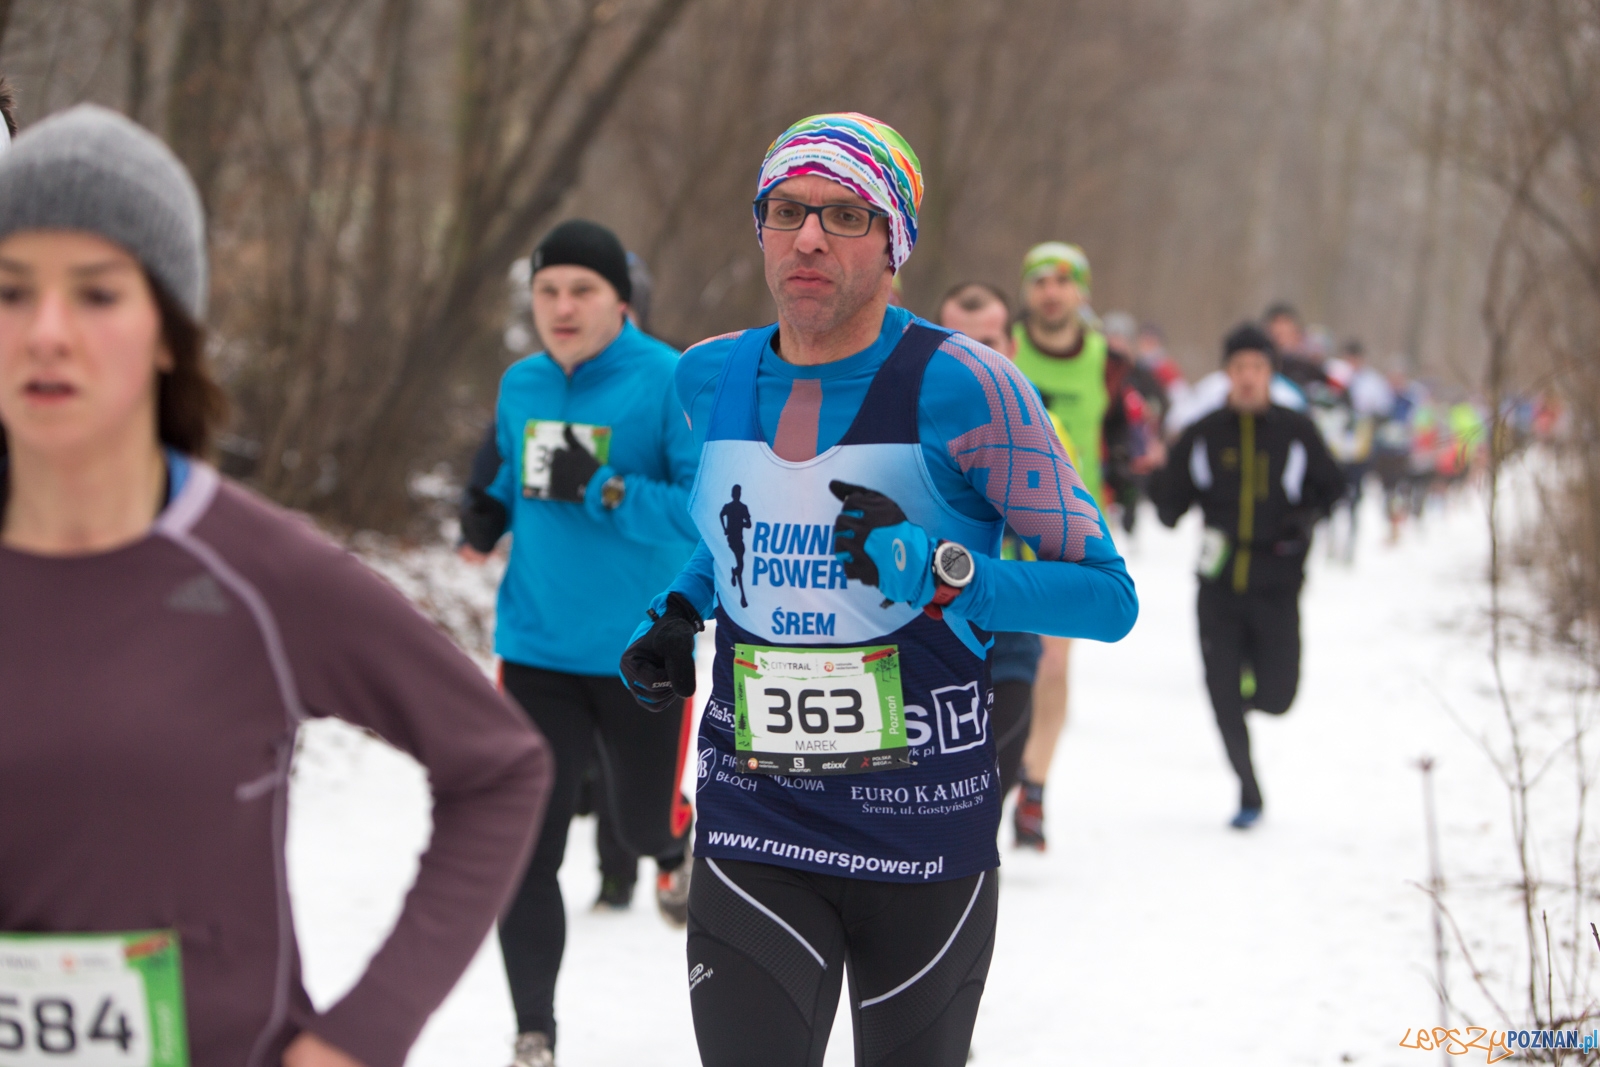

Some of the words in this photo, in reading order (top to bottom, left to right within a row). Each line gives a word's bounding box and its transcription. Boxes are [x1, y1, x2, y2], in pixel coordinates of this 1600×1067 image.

[752, 556, 848, 590] POWER
[771, 606, 836, 637] ŚREM
[764, 688, 865, 734] 363
[885, 695, 900, 735] Poznań
[795, 739, 837, 752] MAREK
[716, 771, 758, 792] BŁOCH
[851, 786, 910, 803] EURO
[862, 802, 897, 815] Śrem,
[900, 806, 915, 815] ul.
[918, 800, 973, 815] Gostyńska
[708, 831, 944, 880] www.runnerspower.pl
